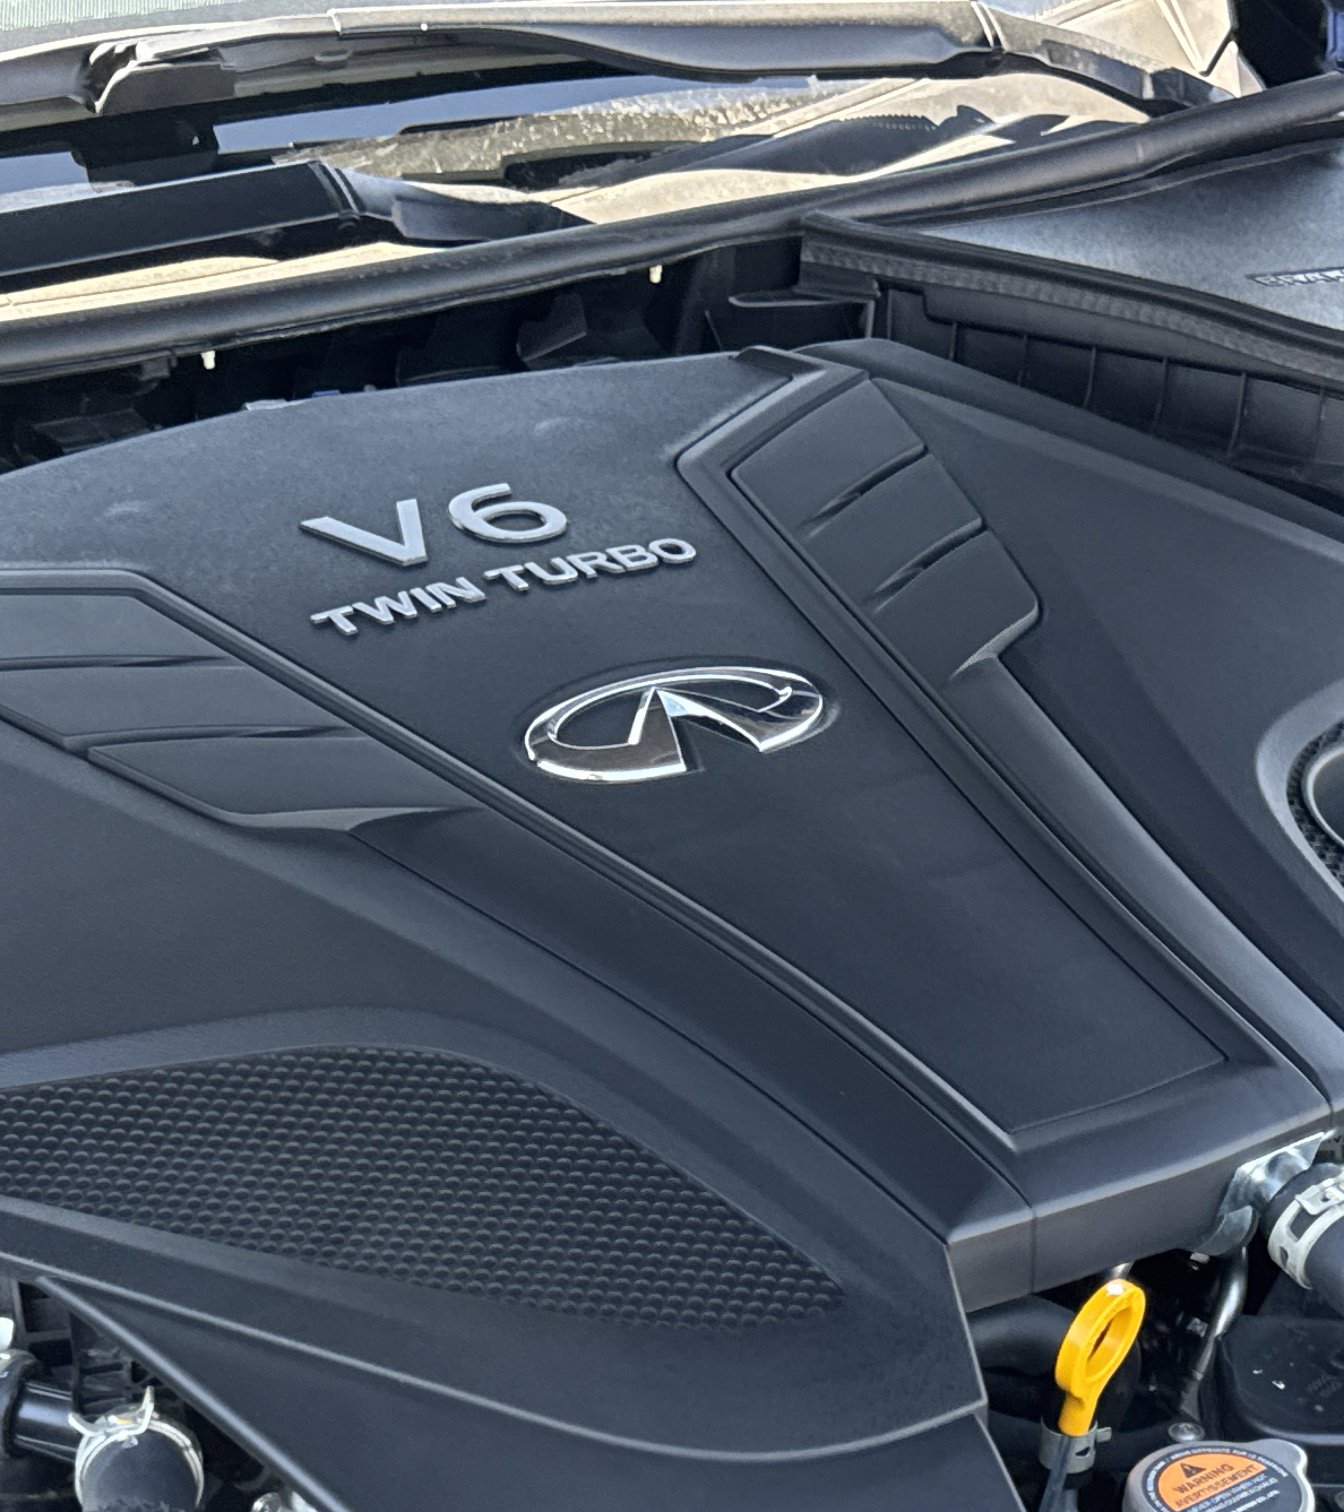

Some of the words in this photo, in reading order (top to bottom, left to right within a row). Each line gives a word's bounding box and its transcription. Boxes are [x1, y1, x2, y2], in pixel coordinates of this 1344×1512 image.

[299, 483, 567, 567] V6
[310, 576, 486, 636] TWIN
[485, 538, 697, 591] TURBO
[1172, 1463, 1234, 1494] WARNING
[1175, 1464, 1256, 1507] AVERTISSEMENT
